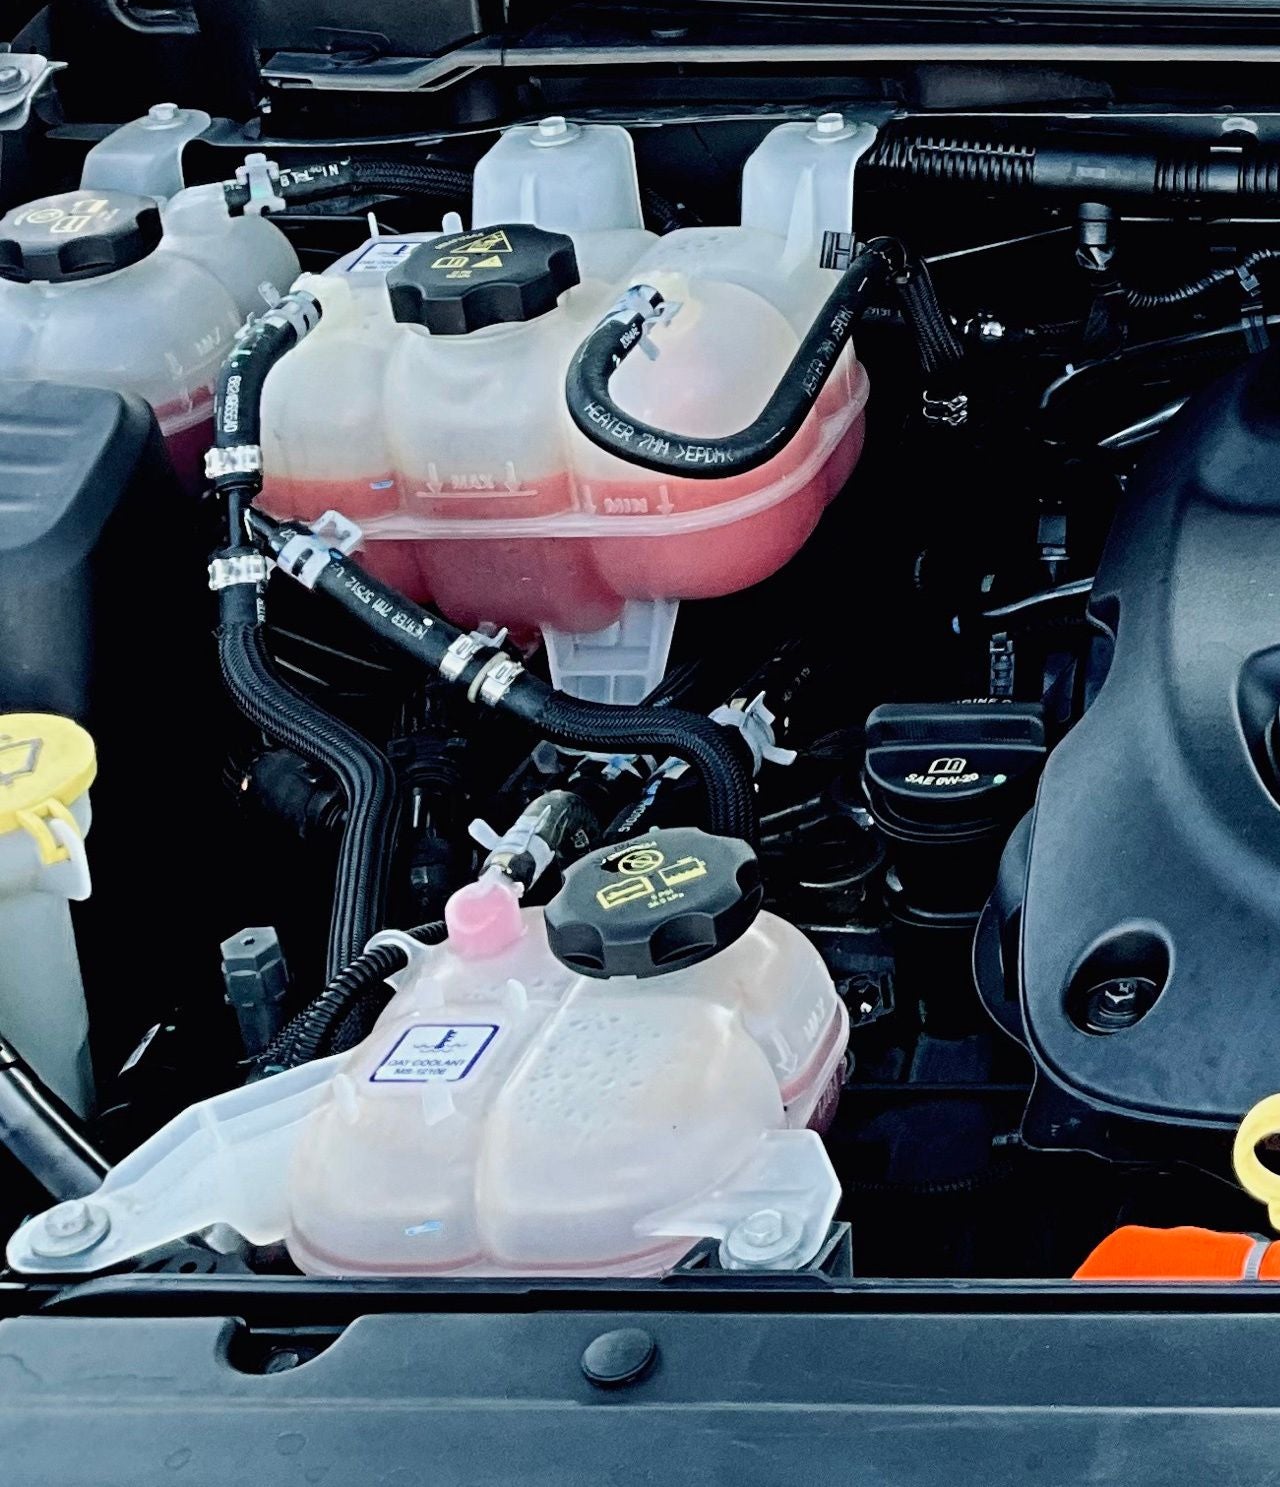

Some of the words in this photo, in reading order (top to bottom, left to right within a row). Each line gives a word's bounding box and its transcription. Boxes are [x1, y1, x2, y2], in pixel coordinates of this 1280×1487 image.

[584, 402, 636, 444] HEATER
[450, 473, 496, 491] MAX
[603, 497, 649, 515] MIN
[905, 773, 936, 786] SAE
[935, 772, 980, 786] 0W-20
